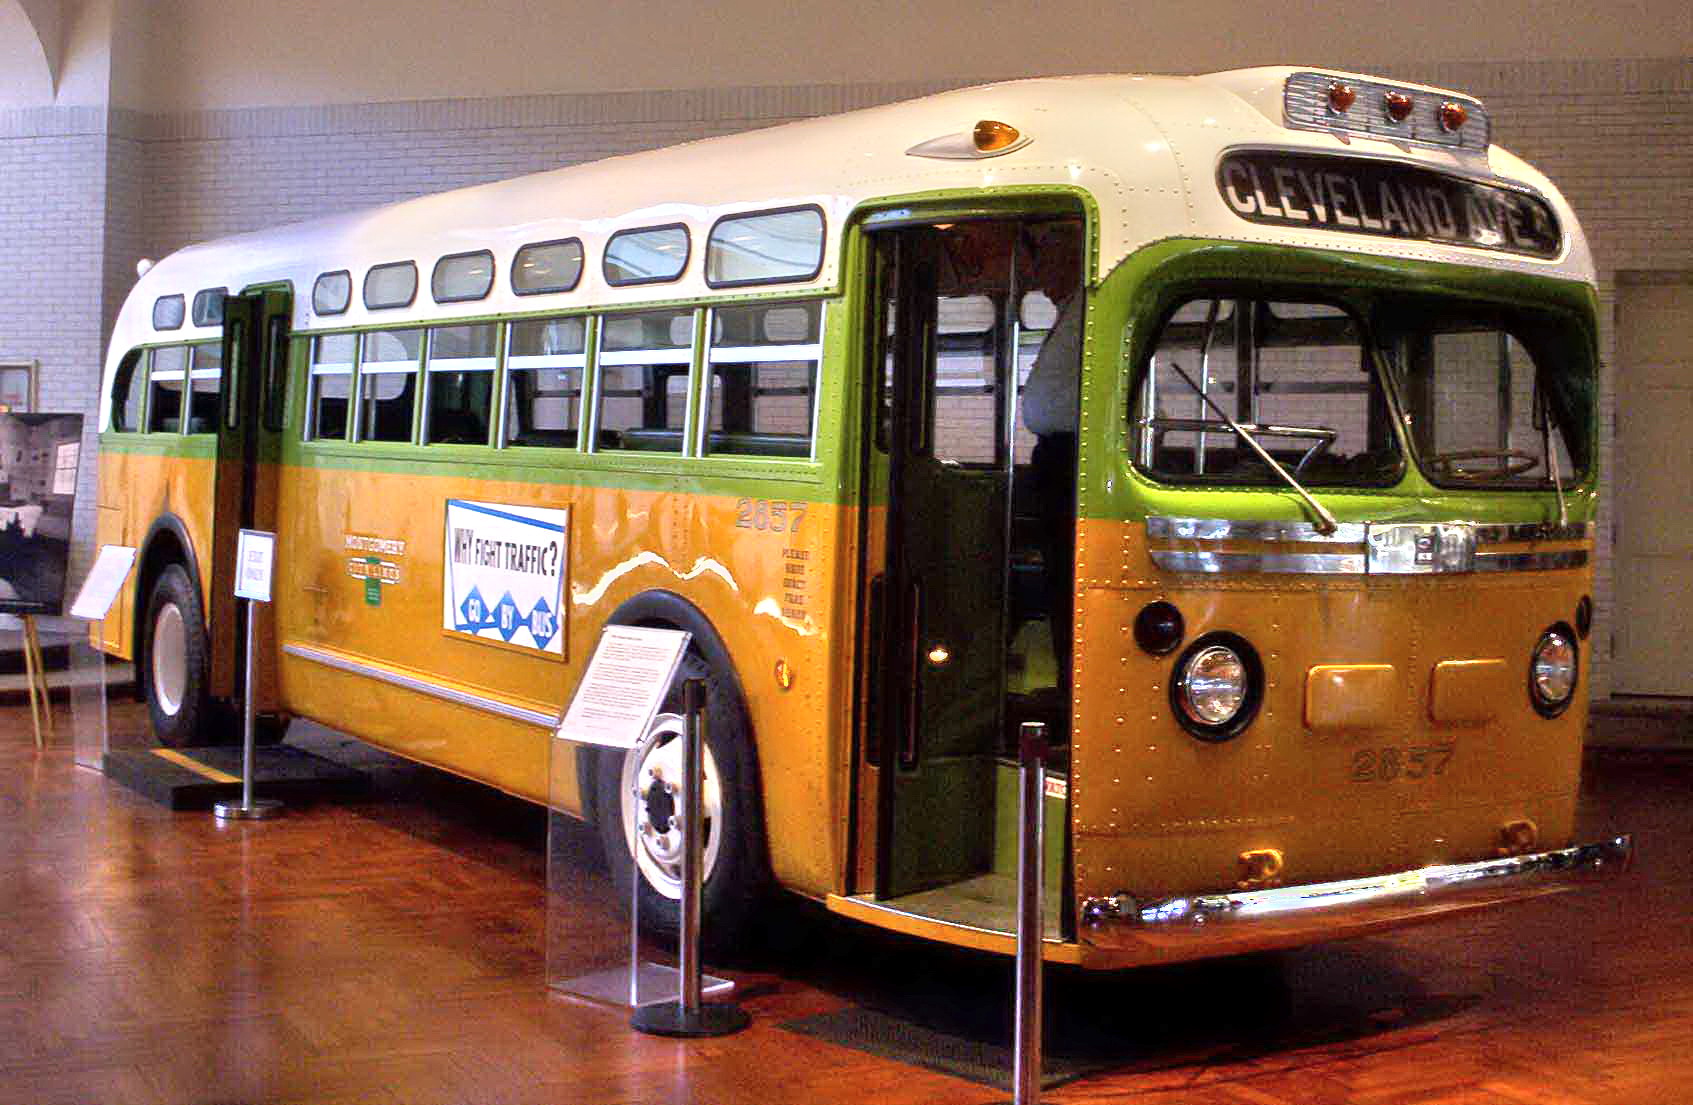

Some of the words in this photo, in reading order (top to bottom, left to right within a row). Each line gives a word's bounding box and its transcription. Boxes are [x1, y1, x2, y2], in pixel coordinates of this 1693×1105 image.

[1223, 157, 1455, 240] CLEVELAND
[736, 496, 808, 532] 2857
[454, 527, 474, 565] WHY
[475, 538, 502, 569] FIGHT
[504, 541, 558, 577] TRAFFIC?
[468, 598, 481, 624] GO
[501, 603, 515, 630] BY
[531, 609, 553, 638] BUS
[1351, 744, 1456, 783] 2857
